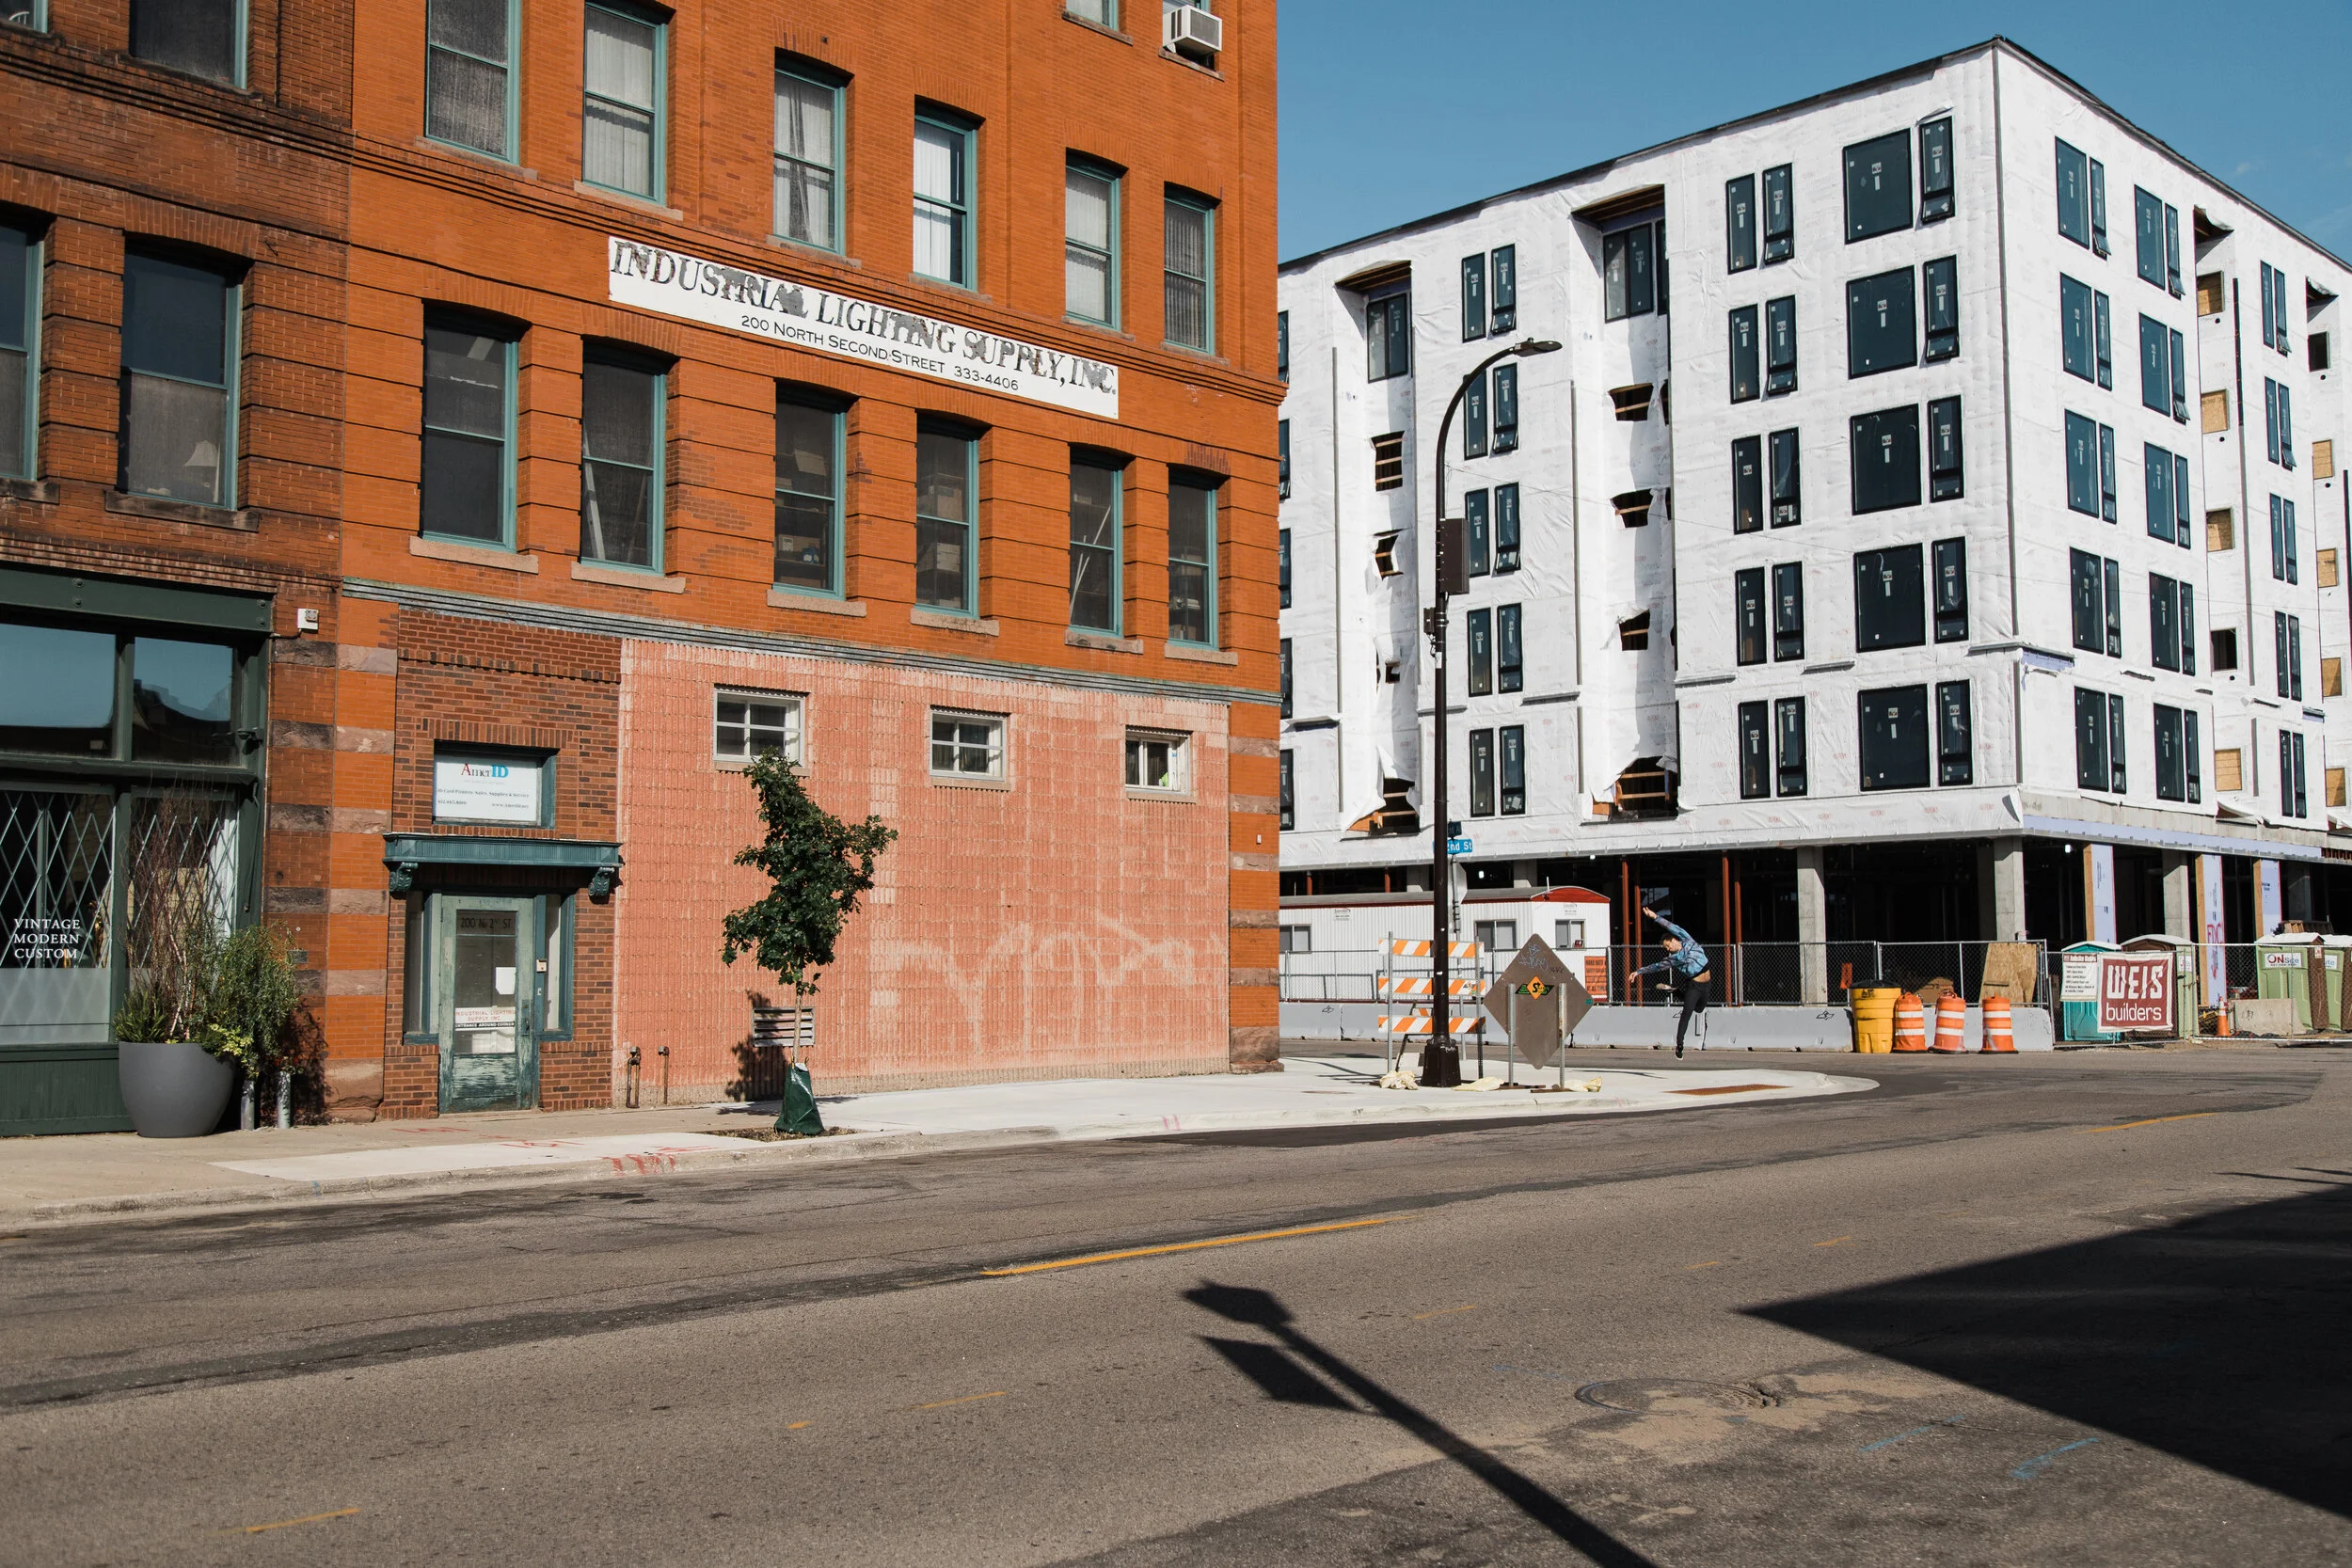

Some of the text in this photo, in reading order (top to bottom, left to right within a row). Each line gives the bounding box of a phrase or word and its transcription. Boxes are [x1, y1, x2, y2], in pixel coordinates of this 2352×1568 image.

[816, 293, 956, 355] LIGHTING
[741, 315, 770, 331] 200
[954, 365, 1019, 391] 333-4406
[1463, 841, 1472, 850] St
[14, 918, 81, 930] VINTAGE
[461, 917, 476, 928] 200
[14, 933, 80, 945] MODERN
[14, 947, 78, 959] CUSTOM
[2106, 965, 2164, 1000] WEIS
[2106, 1002, 2162, 1022] builders
